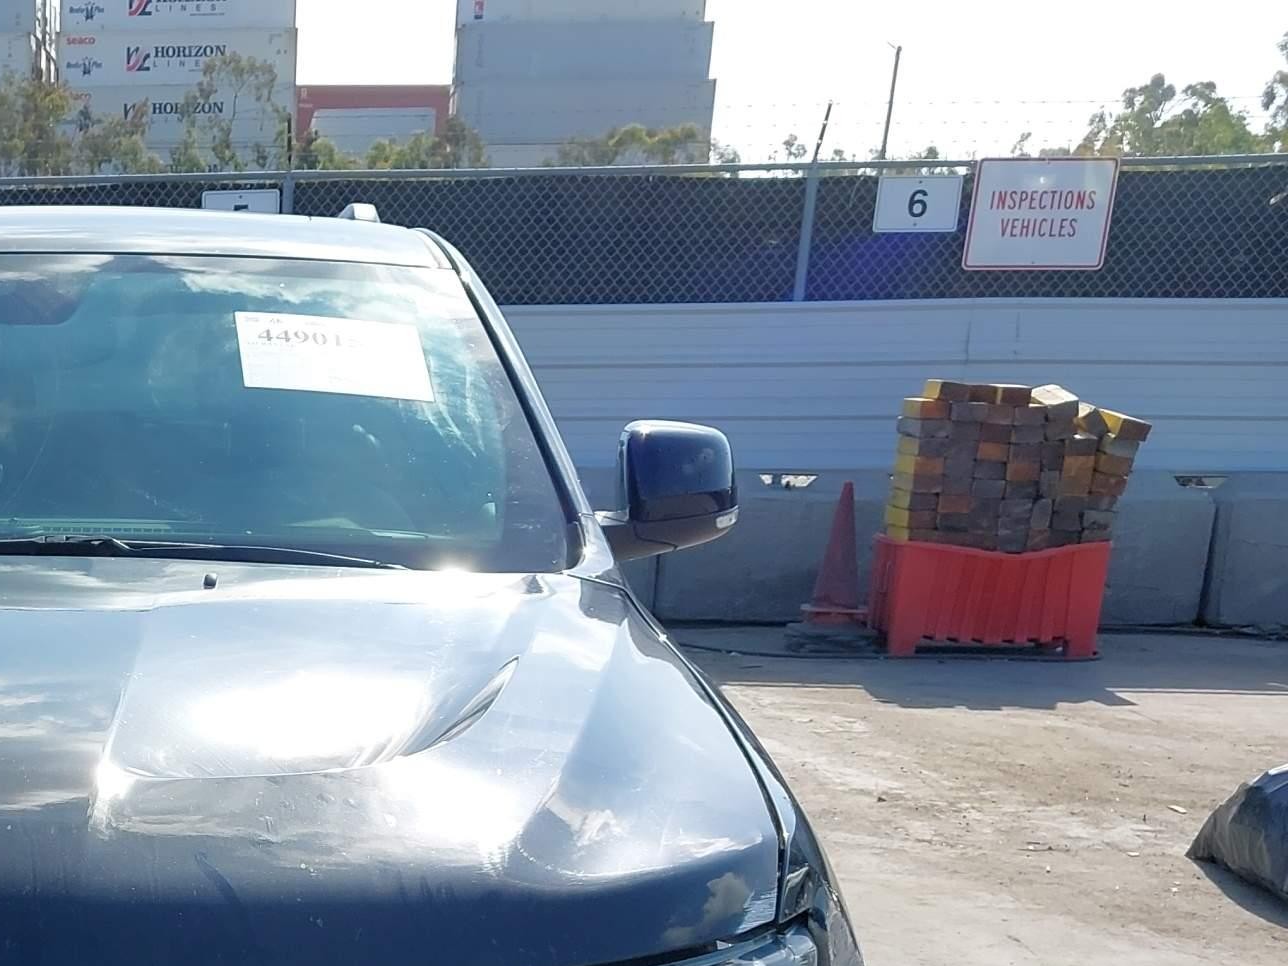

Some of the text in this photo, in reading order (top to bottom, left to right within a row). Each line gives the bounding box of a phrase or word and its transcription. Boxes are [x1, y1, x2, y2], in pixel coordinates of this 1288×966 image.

[155, 4, 217, 12] LINES
[66, 36, 96, 46] seaco
[153, 45, 227, 58] HORIZON
[153, 60, 201, 68] LINE
[152, 101, 225, 115] HORZON
[907, 188, 929, 218] 6
[989, 190, 1097, 211] INSPECTIONS
[1000, 218, 1078, 238] VEHICLES
